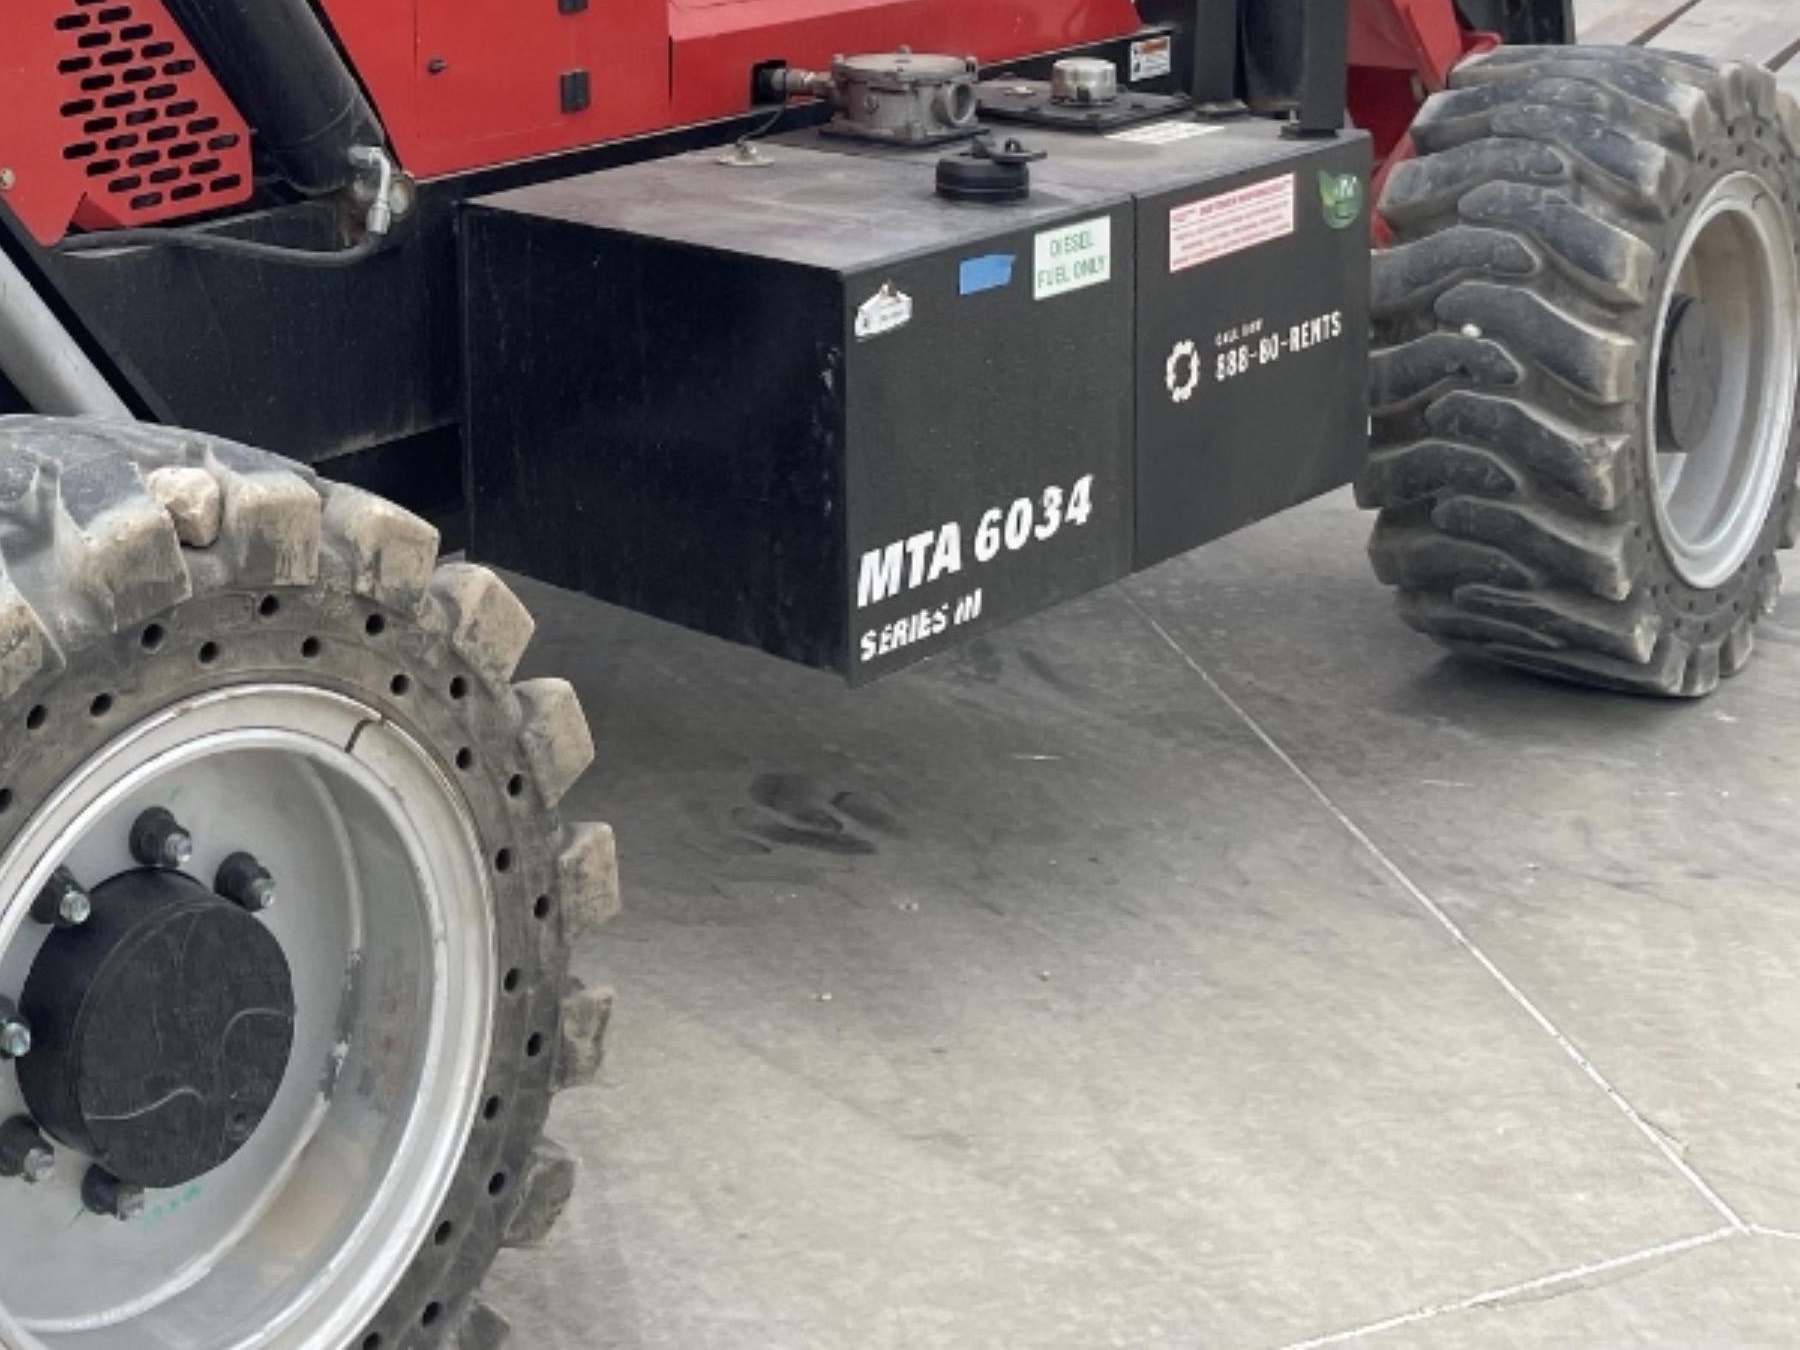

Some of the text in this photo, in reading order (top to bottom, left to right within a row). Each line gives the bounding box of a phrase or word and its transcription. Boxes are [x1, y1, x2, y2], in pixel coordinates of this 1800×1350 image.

[1049, 231, 1096, 258] DIESEL
[1038, 254, 1106, 289] FUEL ONLY
[856, 473, 1096, 610] MTA 6034
[860, 602, 950, 663] SERIES
